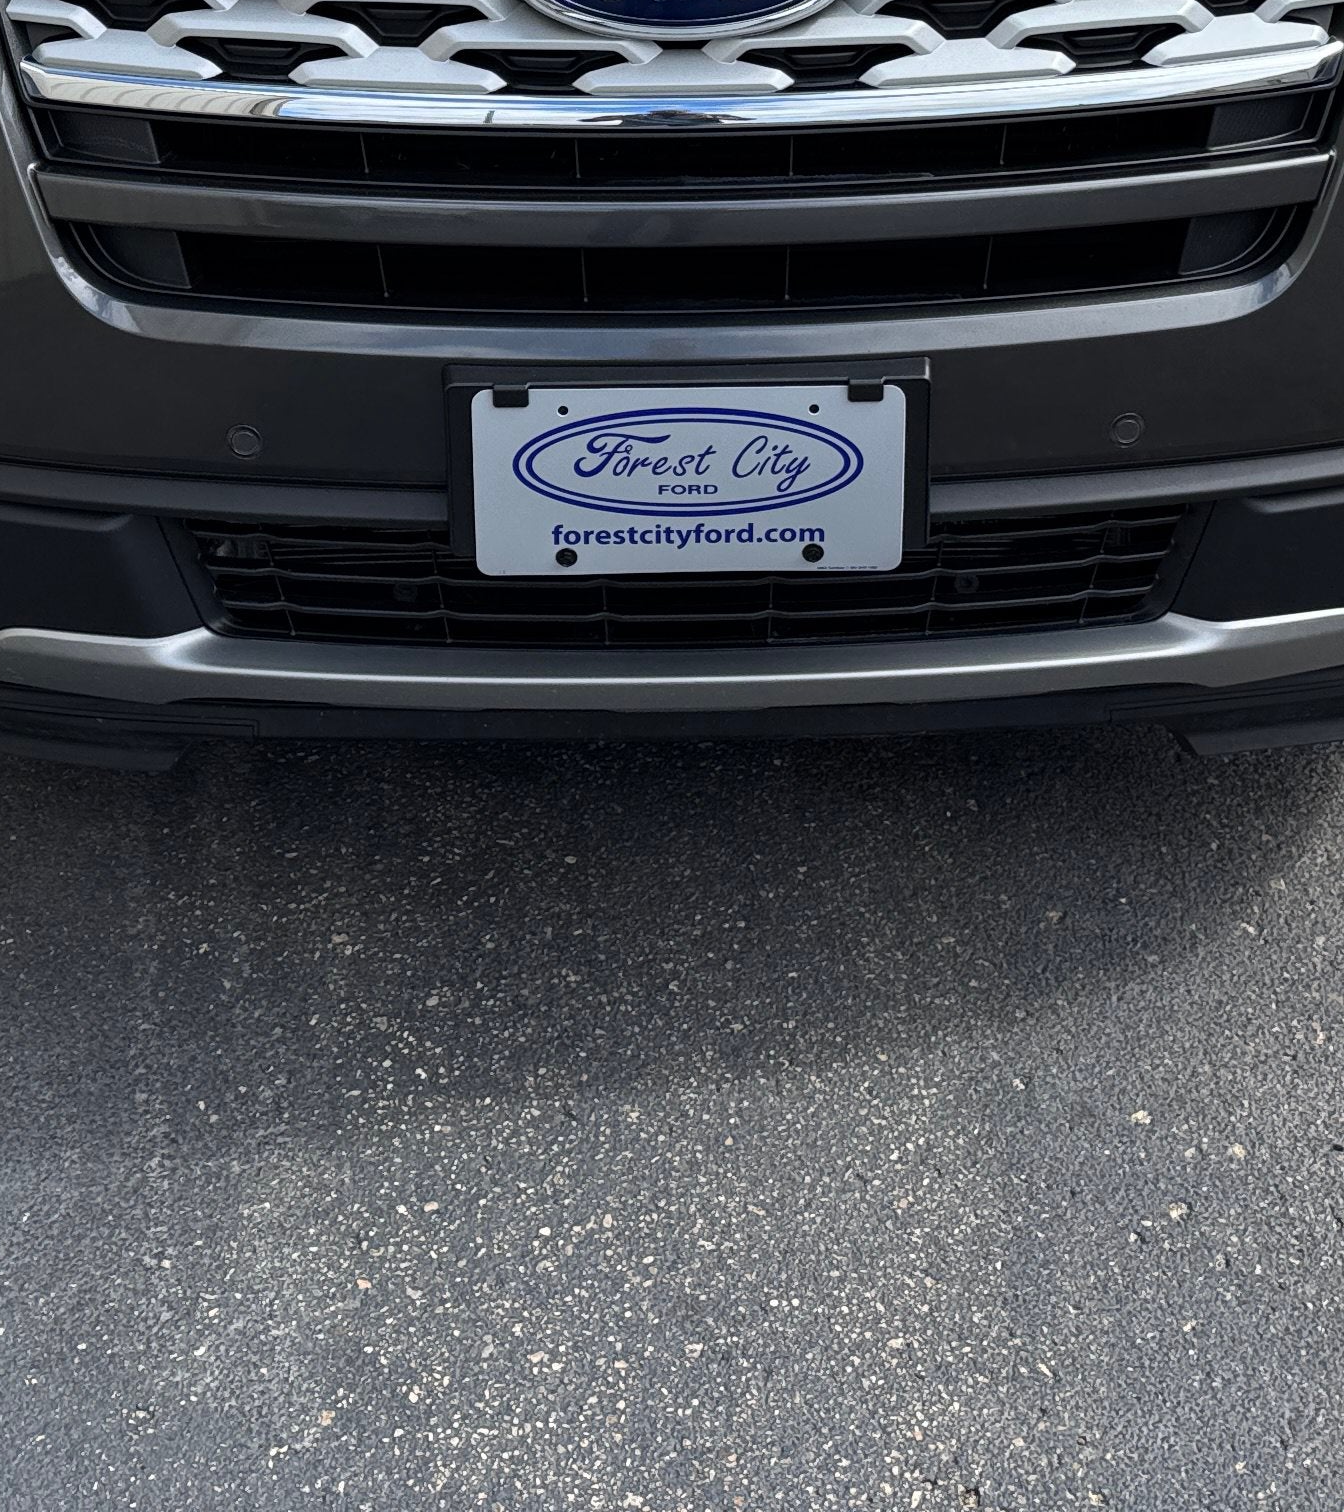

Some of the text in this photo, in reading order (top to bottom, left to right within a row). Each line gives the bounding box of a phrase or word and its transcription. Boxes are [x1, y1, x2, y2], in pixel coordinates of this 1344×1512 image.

[573, 432, 812, 493] Forest City
[657, 484, 719, 495] FORD
[551, 522, 826, 550] forestcityford.com
